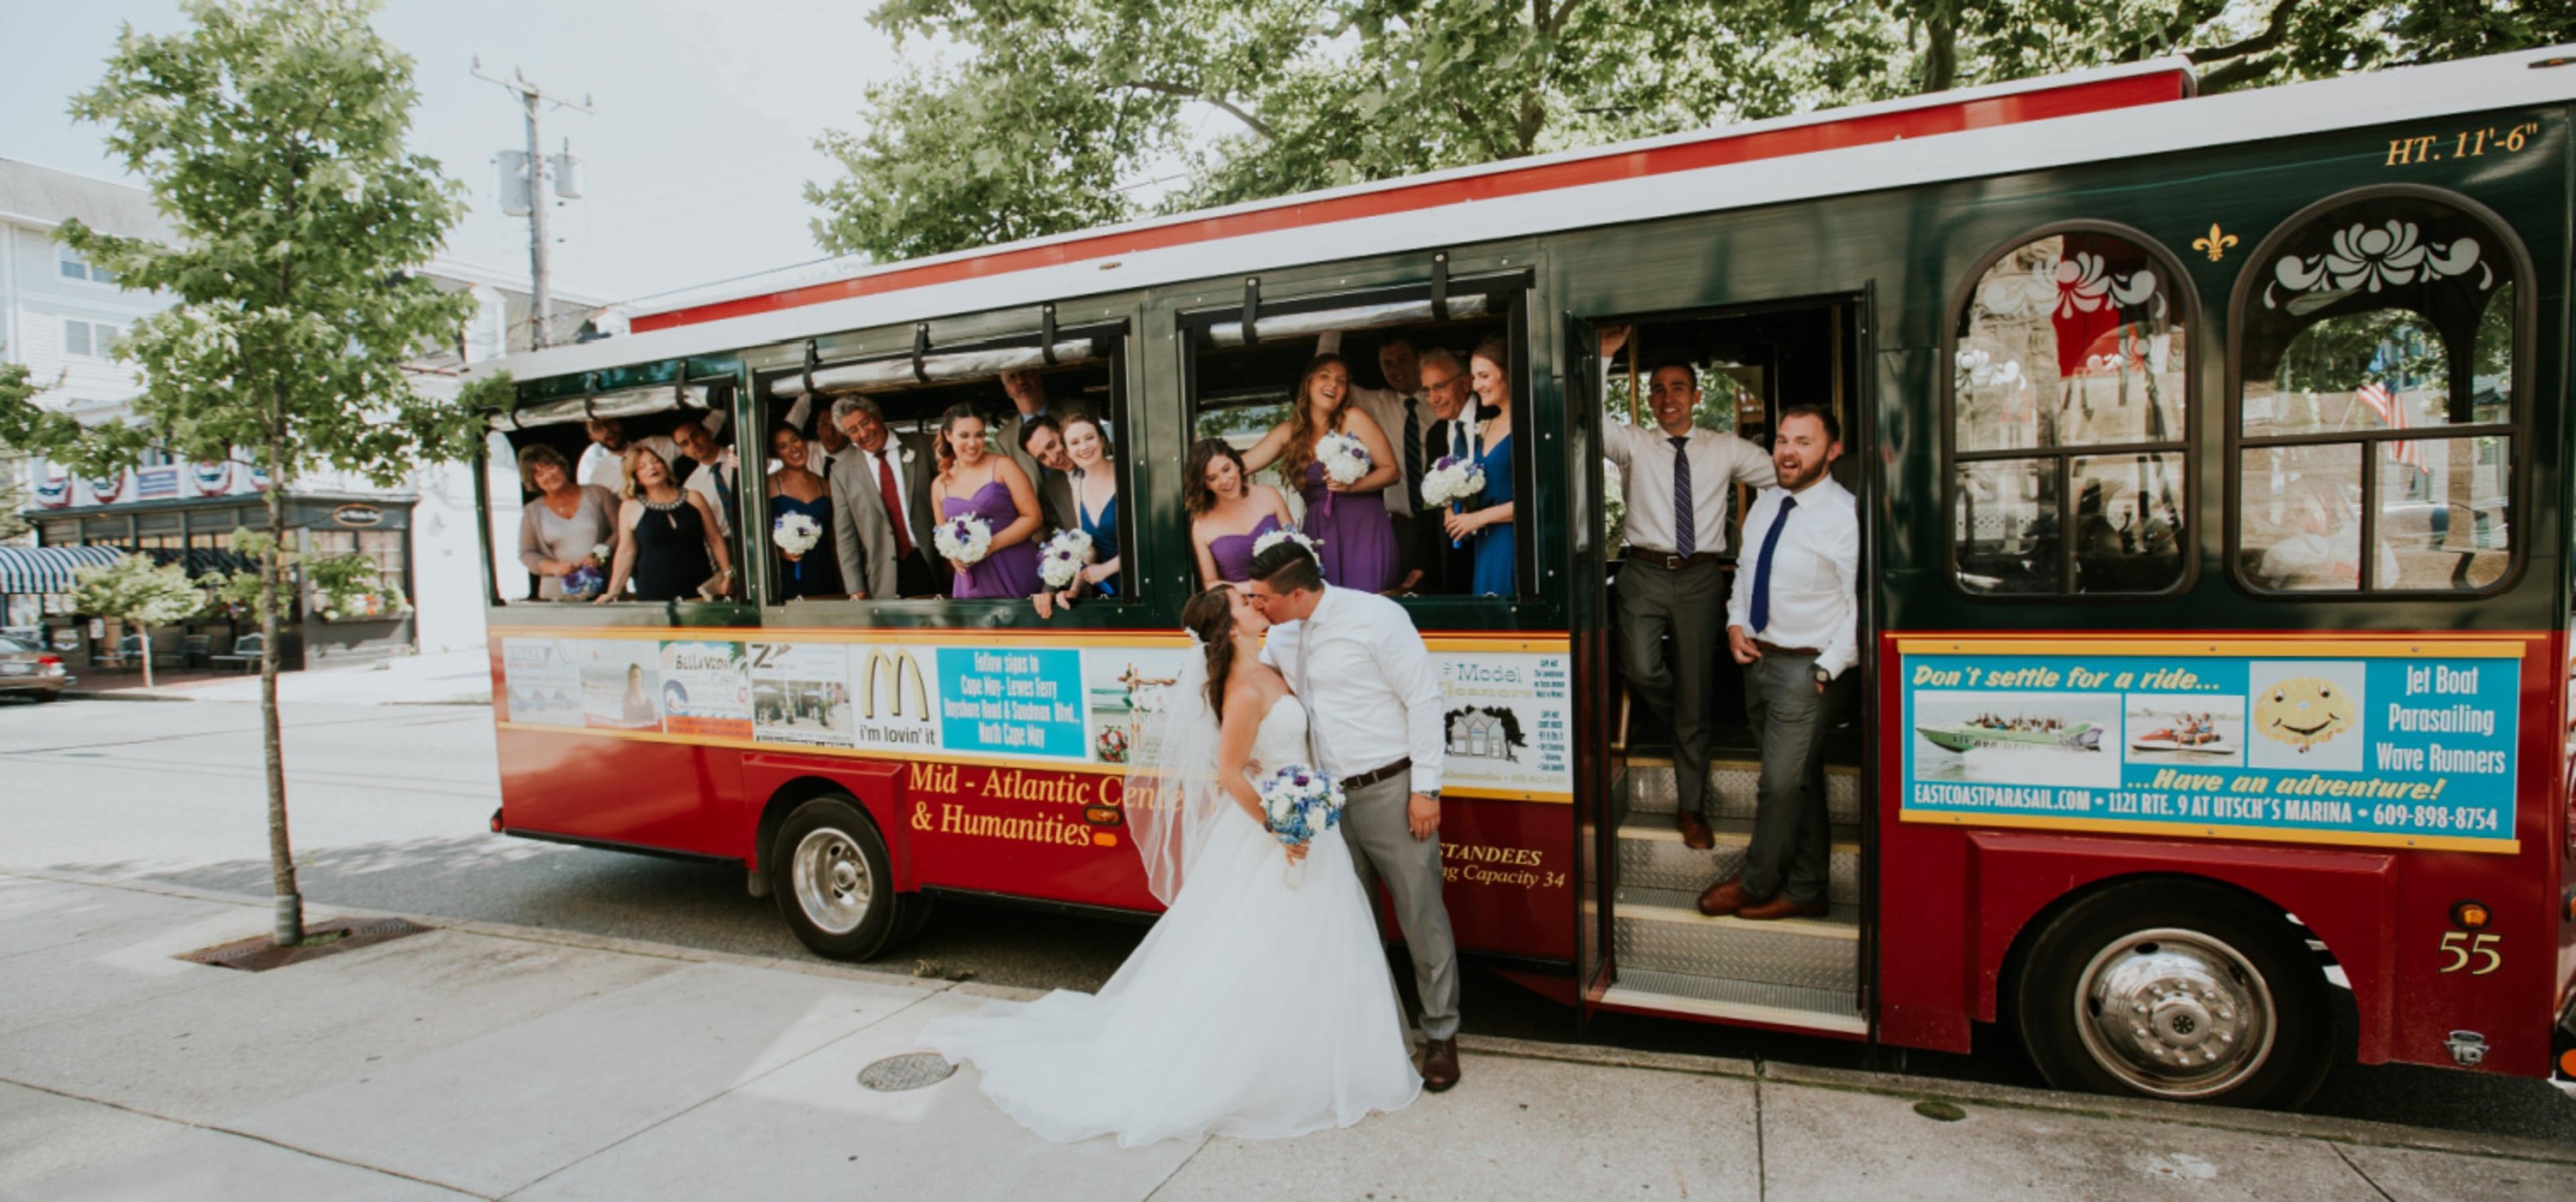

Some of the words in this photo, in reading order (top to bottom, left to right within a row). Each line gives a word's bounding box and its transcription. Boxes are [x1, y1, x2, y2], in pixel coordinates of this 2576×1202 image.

[2385, 135, 2441, 166] HT.
[2452, 121, 2539, 159] 11'-6"
[975, 652, 1002, 672] Follow
[1005, 652, 1027, 675] signs
[1030, 653, 1039, 673] to
[1457, 663, 1522, 683] Model
[1913, 665, 1982, 686] Don't
[1985, 666, 2059, 688] settle
[2067, 667, 2108, 689] for
[2114, 672, 2134, 689] a
[2139, 668, 2220, 690] ride...
[961, 674, 982, 697] Cape
[2406, 665, 2431, 696] Jet
[2436, 665, 2479, 695] Boat
[2388, 703, 2495, 736] Parasailing
[860, 724, 880, 741] i'm
[884, 726, 922, 744] lovin'
[926, 728, 935, 745] it
[979, 722, 1002, 744] North
[1004, 722, 1025, 747] Cape
[1027, 724, 1044, 749] May
[2376, 741, 2424, 771] Wave
[2429, 743, 2506, 774] Runners
[908, 762, 958, 795] Mid
[981, 768, 1090, 806] Atlantic
[2231, 775, 2269, 794] an
[2275, 774, 2448, 801] adventure!
[1914, 783, 2090, 812] EASTCOASTPARASAIL.COM
[2108, 792, 2139, 814] 1121
[2141, 794, 2174, 816] RTE.
[2178, 795, 2188, 816] 9
[2191, 796, 2210, 817] AT
[2214, 797, 2282, 820] UTSCH'S
[2284, 800, 2353, 824] MARINA
[2373, 805, 2498, 830] 609-898-8754
[911, 802, 933, 831] &
[941, 804, 1091, 846] Humanities
[1463, 865, 1540, 889] Capacity
[1543, 872, 1566, 888] 34
[2440, 932, 2502, 975] 55
